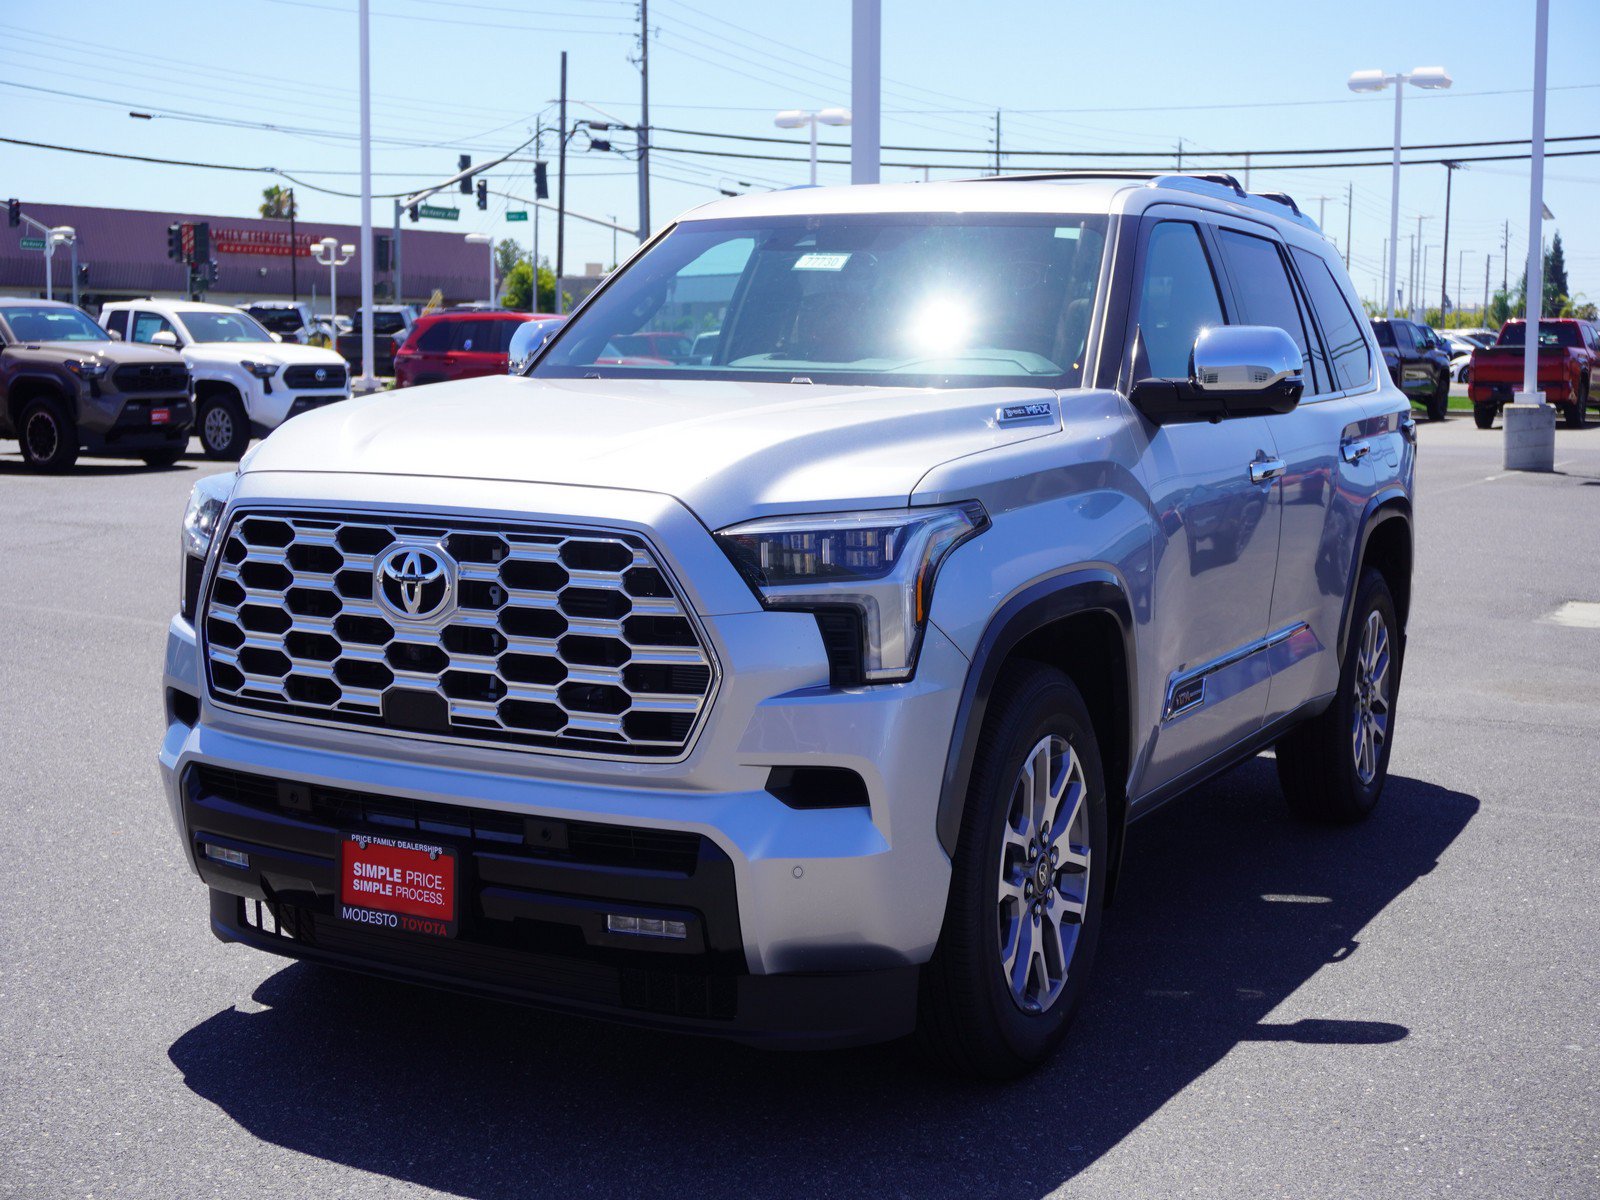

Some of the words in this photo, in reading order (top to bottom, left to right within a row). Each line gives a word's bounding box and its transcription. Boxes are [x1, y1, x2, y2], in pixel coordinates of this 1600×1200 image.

[209, 229, 243, 240] AMILY
[273, 247, 306, 255] CENER
[351, 834, 372, 844] PRICE
[373, 837, 396, 847] FAMILY
[398, 840, 443, 855] DEALERSHIPS
[353, 862, 402, 883] SIMPLE
[405, 870, 446, 891] PRICE.
[353, 879, 393, 897] SIMPLE
[396, 886, 445, 906] PROCESS.
[342, 906, 398, 928] MODESTO
[401, 917, 447, 937] TOYOTA
